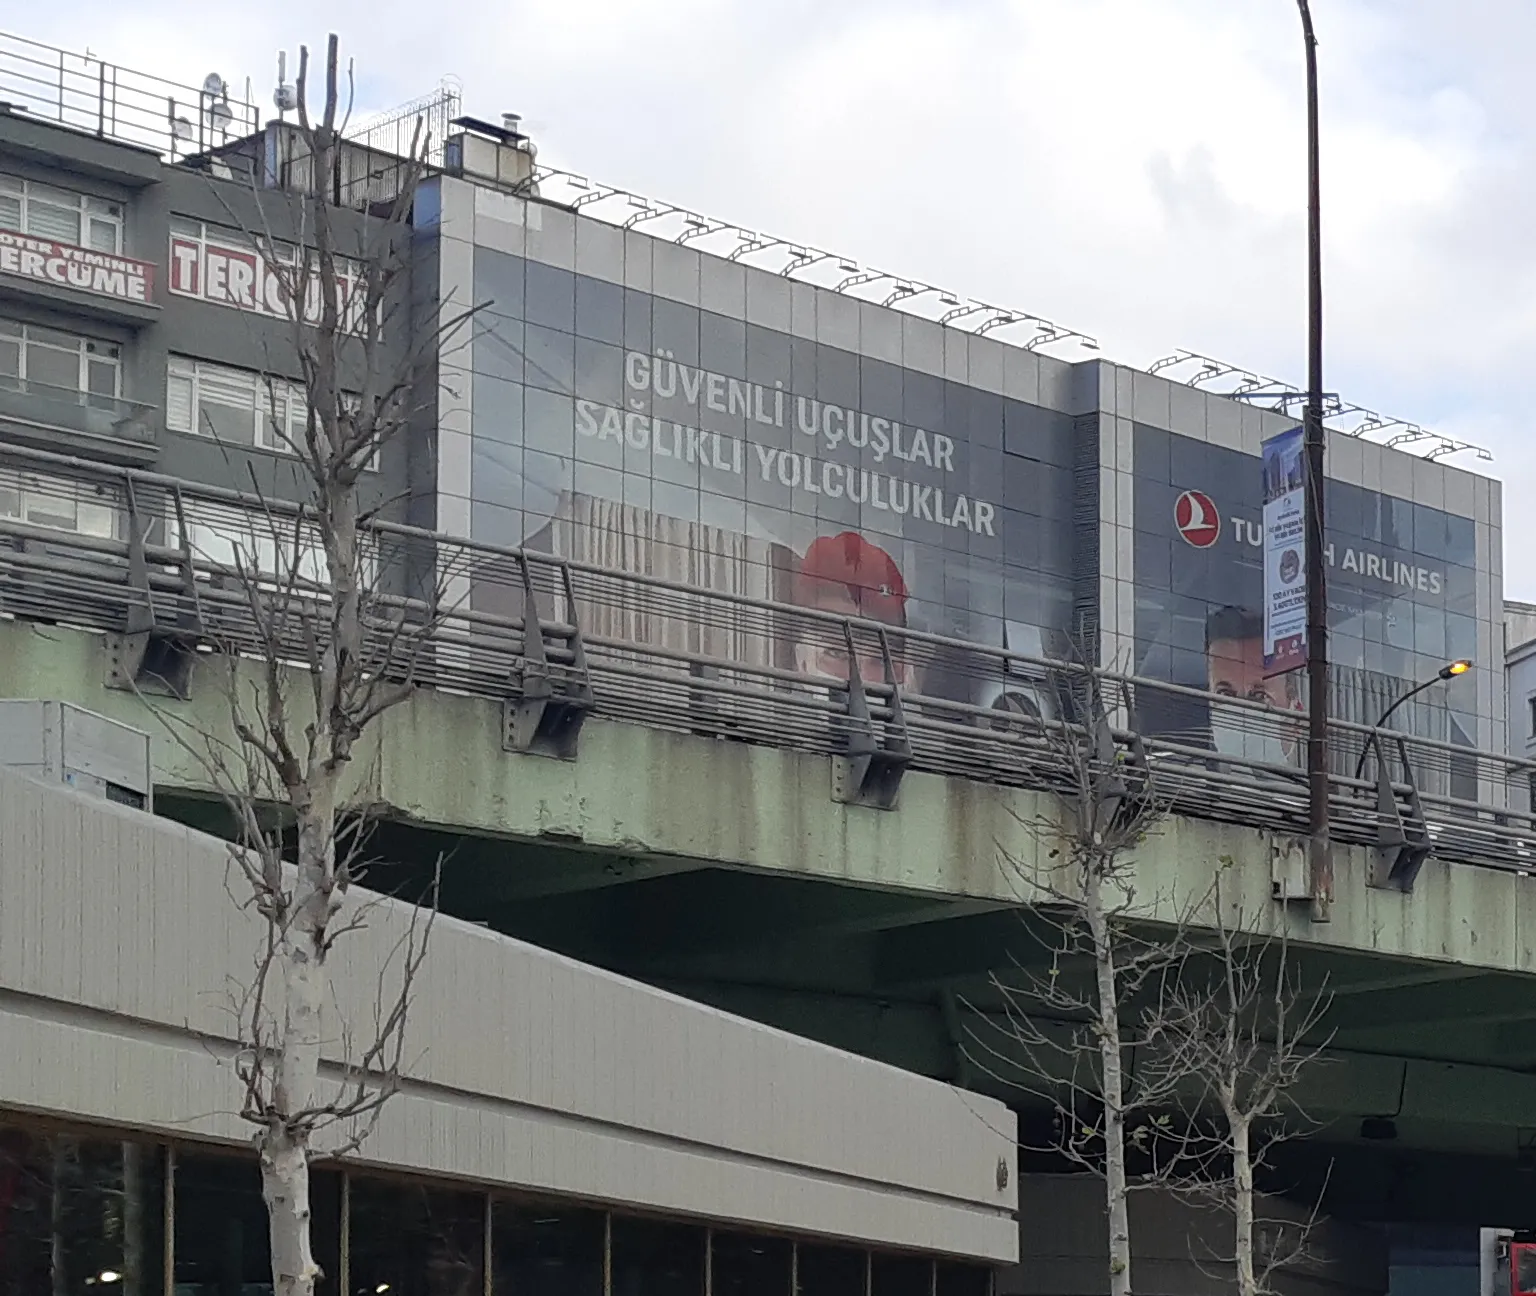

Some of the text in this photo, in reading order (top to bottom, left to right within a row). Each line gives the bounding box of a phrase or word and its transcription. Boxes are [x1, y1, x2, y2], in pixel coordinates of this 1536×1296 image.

[574, 398, 996, 538] SAĞLIKLI YOLCULUKLAR
[625, 347, 956, 473] GÜVENLİ UÇUŞLAR
[1230, 516, 1335, 568] TUH
[1341, 548, 1441, 595] AIRLINES
